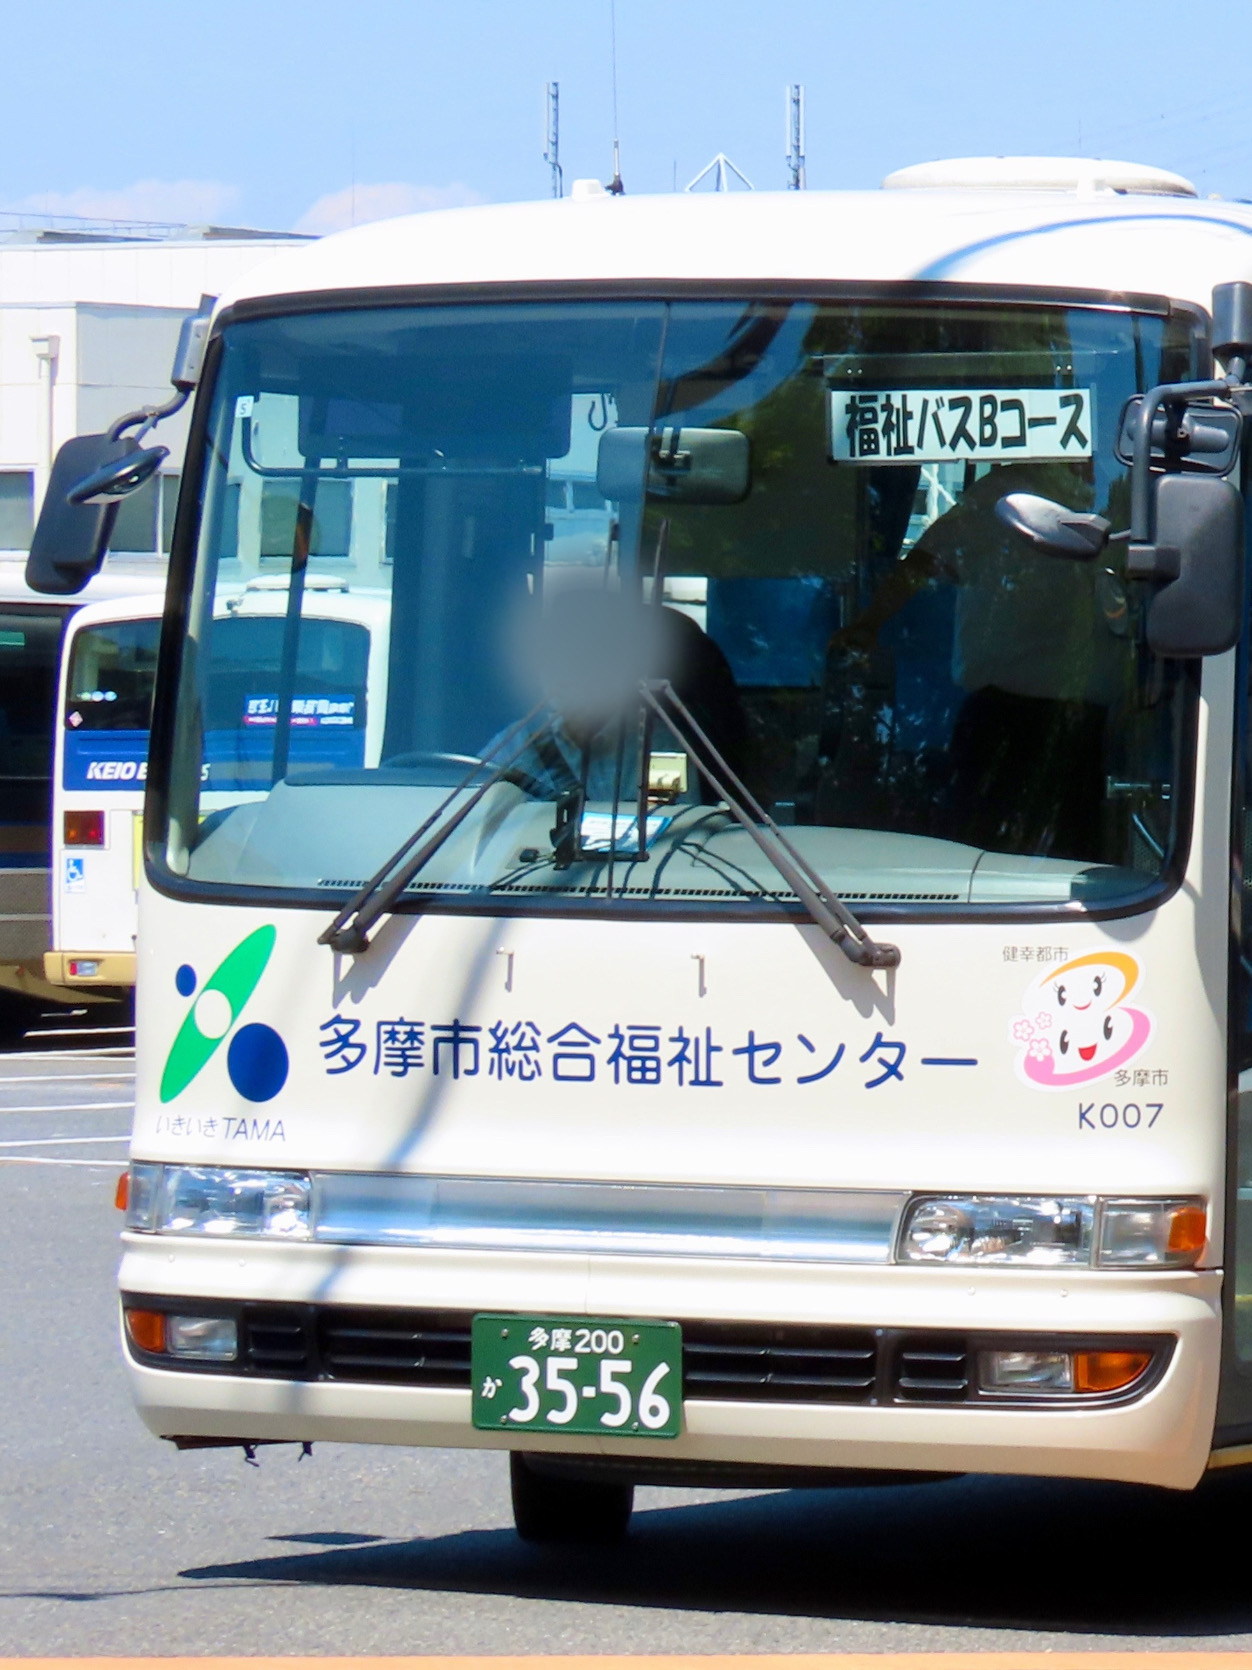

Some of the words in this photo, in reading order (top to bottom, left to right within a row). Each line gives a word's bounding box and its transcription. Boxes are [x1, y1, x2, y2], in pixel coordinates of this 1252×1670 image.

[845, 393, 1089, 458] 福祉バスBコース
[86, 761, 137, 780] KEIO
[1002, 946, 1069, 962] 健幸都市
[319, 1014, 979, 1089] 多摩市総合福祉センター
[1114, 1069, 1170, 1087] 多摩市
[481, 1376, 503, 1399] か
[508, 1355, 671, 1430] 35-56
